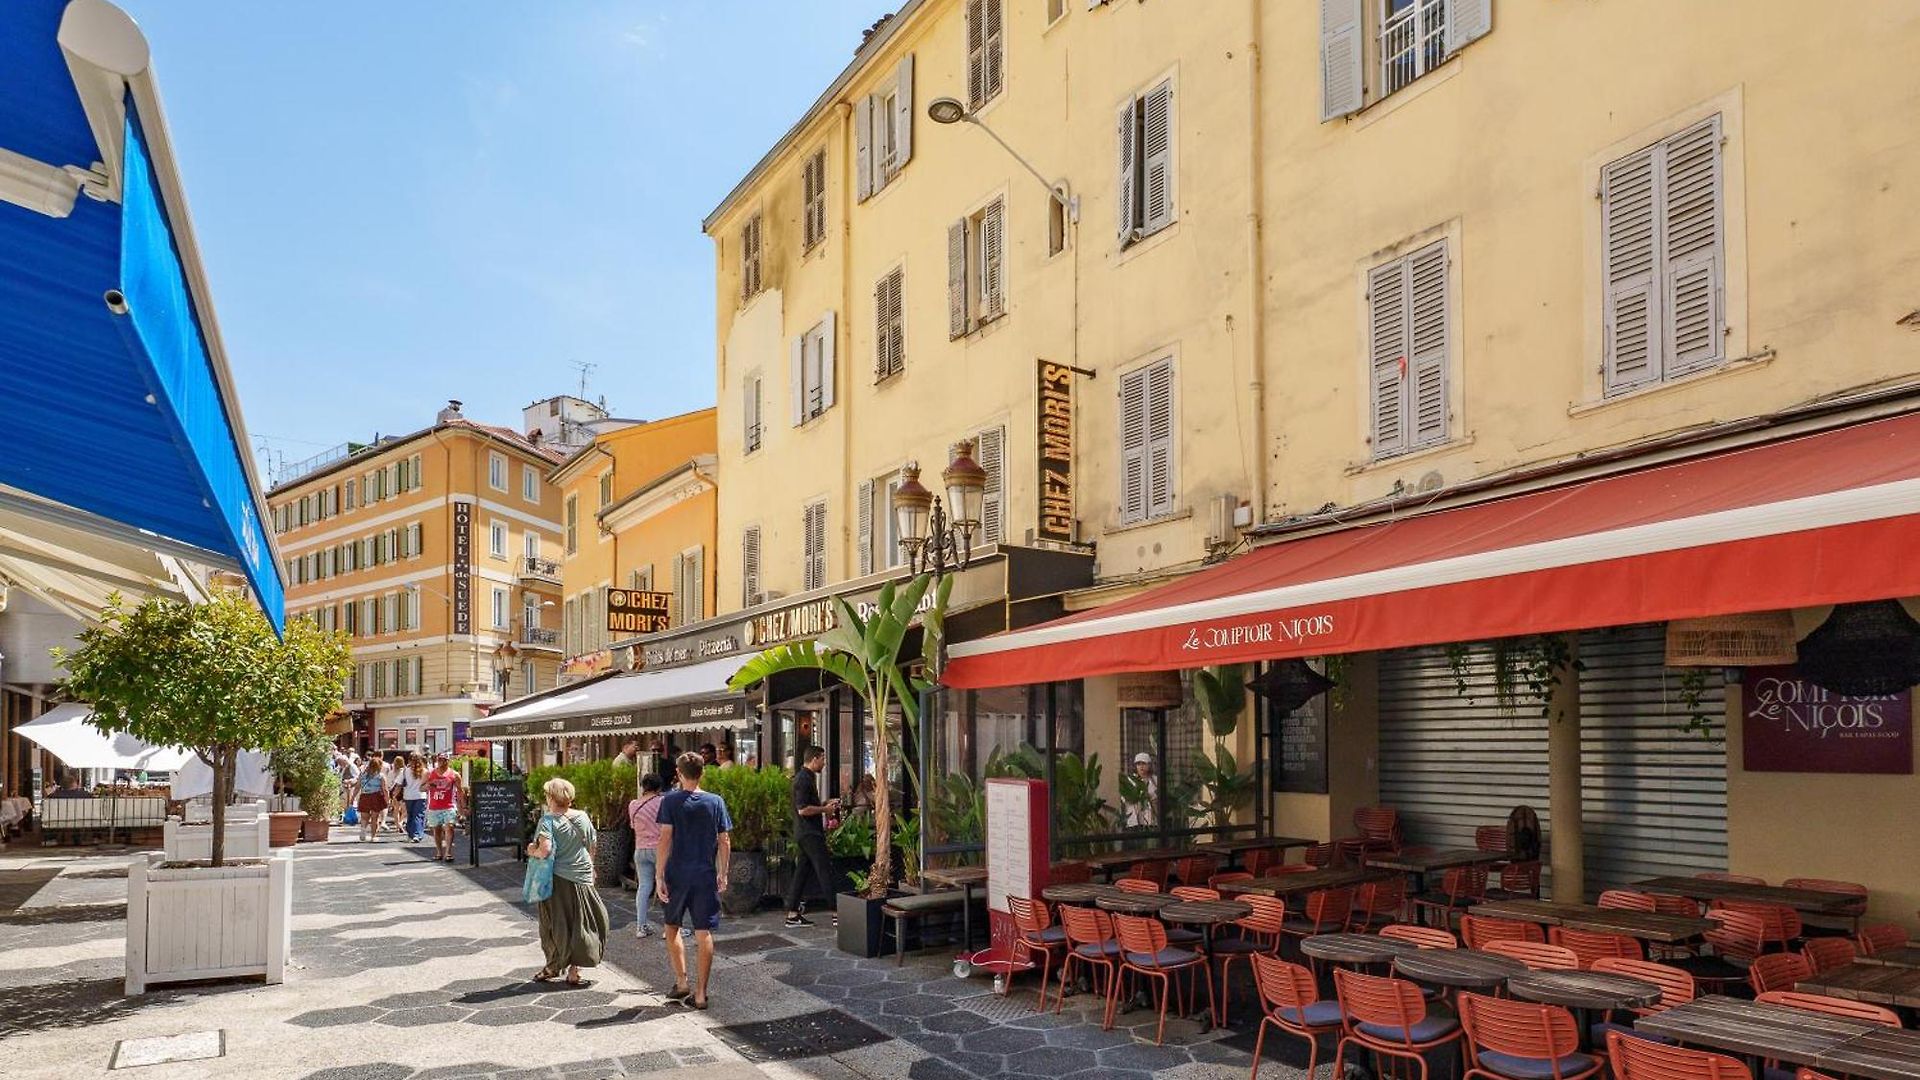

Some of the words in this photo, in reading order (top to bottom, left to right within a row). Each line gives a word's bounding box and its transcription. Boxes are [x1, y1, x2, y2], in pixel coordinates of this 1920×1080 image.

[1044, 364, 1072, 461] MORI'S
[1044, 468, 1072, 535] CHEZ
[457, 503, 468, 556] HOTEL
[458, 580, 468, 632] SUEDE
[632, 591, 668, 610] CHEZ
[609, 612, 667, 632] MORI'S
[759, 610, 786, 643] CHEZ
[789, 599, 834, 637] MORI'S
[1182, 627, 1201, 650] Le
[1204, 622, 1272, 648] COMPTOIR
[1278, 614, 1334, 645] NIÇOIS
[1748, 689, 1782, 720] Le
[1785, 703, 1884, 739] NIÇOIS
